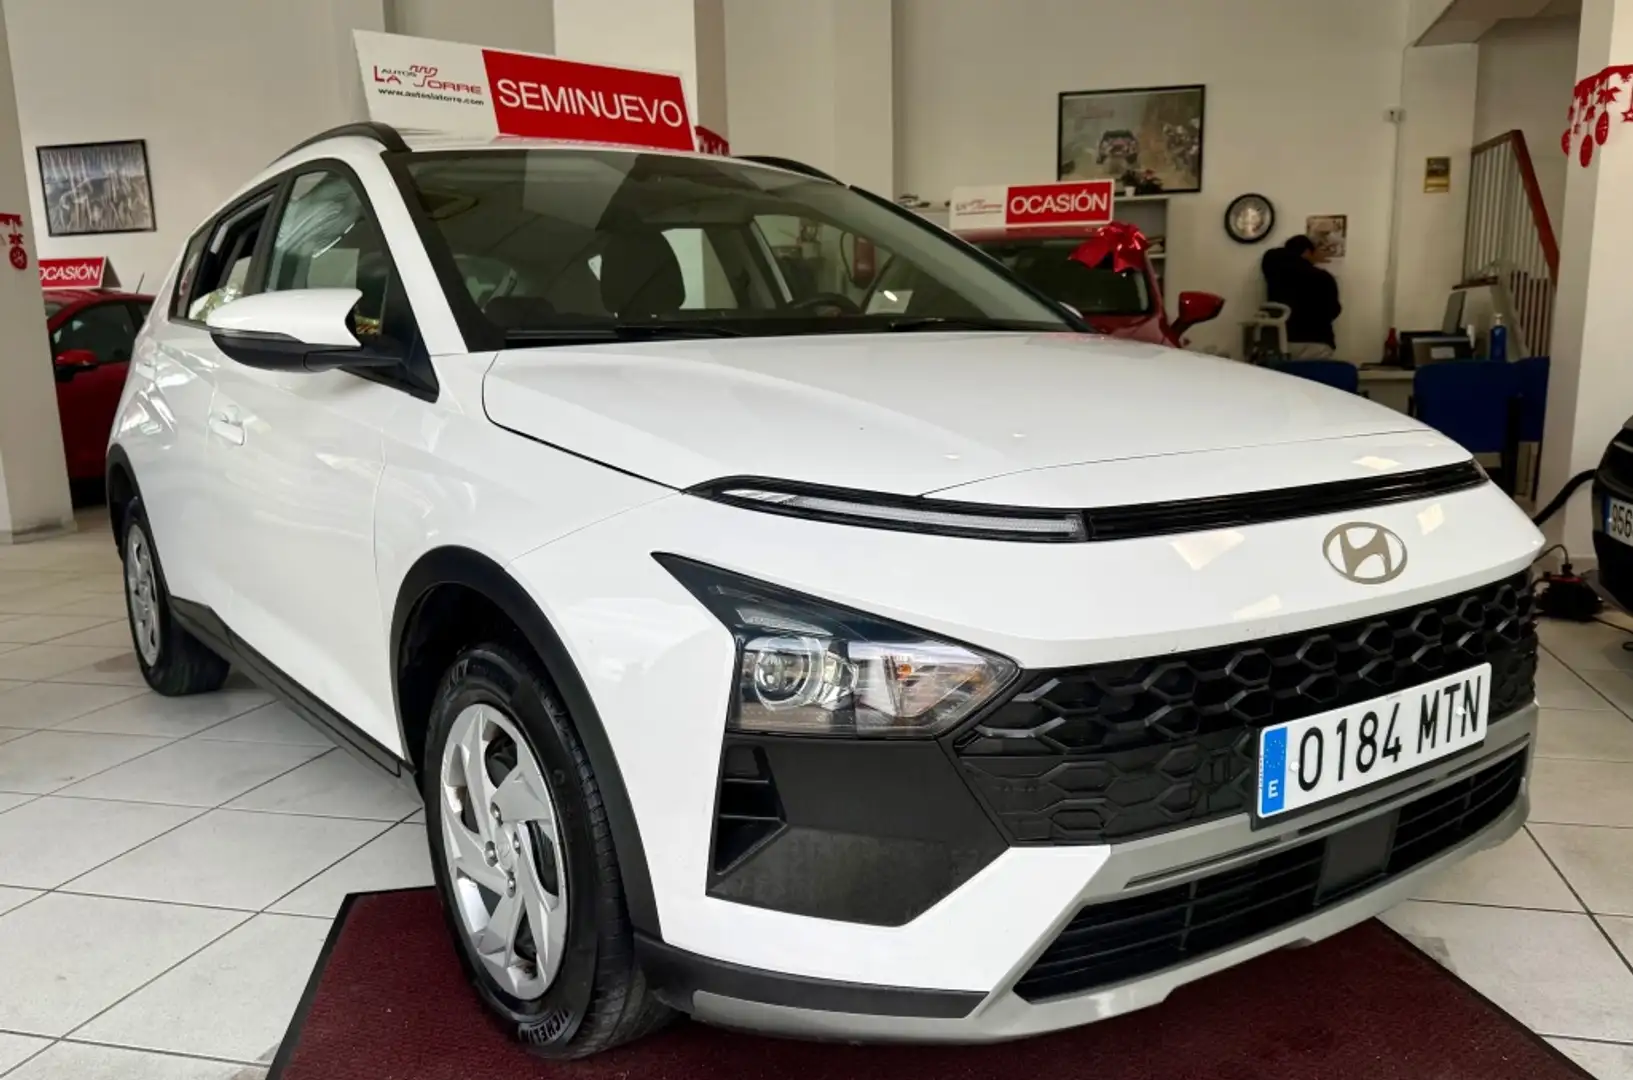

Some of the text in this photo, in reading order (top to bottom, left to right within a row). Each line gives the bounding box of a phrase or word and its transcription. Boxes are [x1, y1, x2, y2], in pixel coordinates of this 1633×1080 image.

[497, 79, 683, 127] SEMINUEVO
[1010, 189, 1108, 214] OCASIÓN
[1298, 675, 1481, 792] 0184 MTN
[1268, 779, 1279, 799] E
